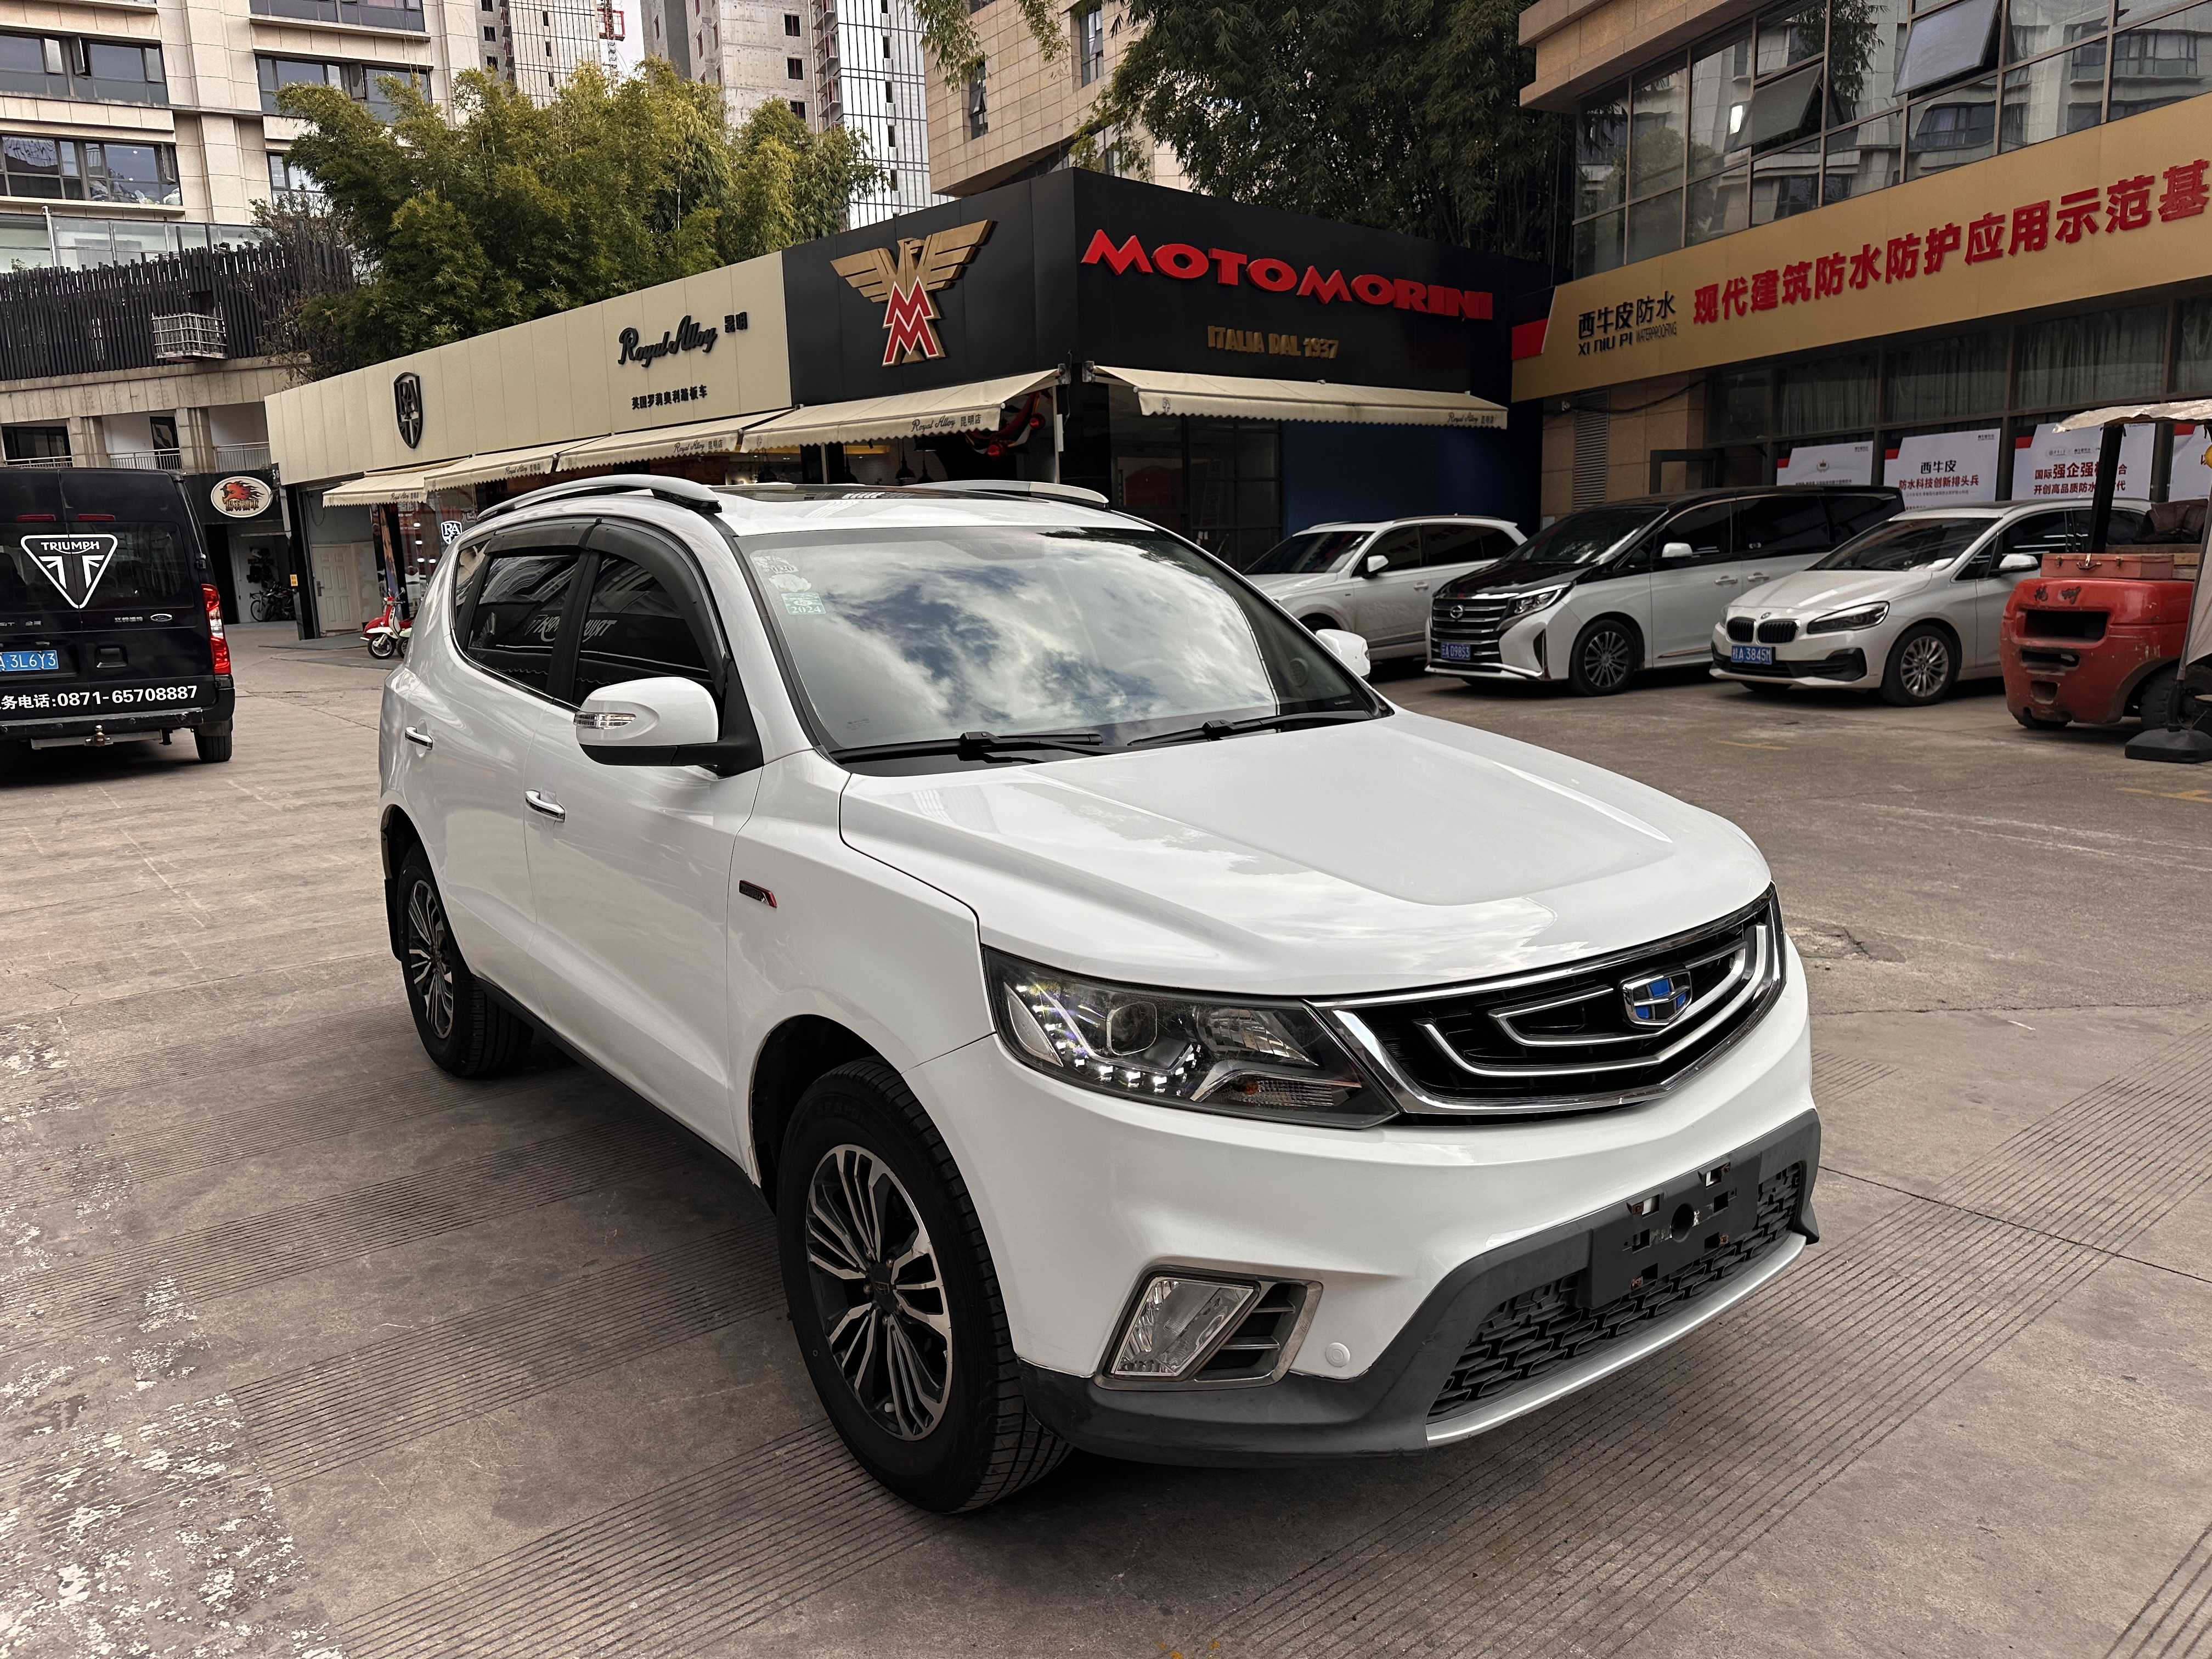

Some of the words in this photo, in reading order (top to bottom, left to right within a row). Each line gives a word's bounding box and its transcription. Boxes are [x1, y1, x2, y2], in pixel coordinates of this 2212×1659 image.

[1693, 158, 2210, 325] 现代建筑防水防护应用示范基
[1578, 290, 1677, 340] 西牛皮防水
[618, 327, 670, 368] Royal
[668, 315, 718, 353] Alloy
[724, 312, 747, 333] 昆明
[1207, 325, 1266, 353] ITALIA
[1268, 333, 1301, 356] DAL
[1304, 337, 1339, 359] 1937
[1578, 341, 1590, 356] XI
[1619, 331, 1633, 348] PI
[1636, 321, 1678, 348] WATERPROOFING
[911, 419, 934, 433] Royal
[935, 415, 955, 428] Alloy
[961, 414, 981, 427] 昆明店
[673, 442, 690, 454] Royal
[691, 439, 704, 451] Alloy
[1920, 459, 1957, 475] 西牛皮
[2034, 461, 2128, 480] 国际强企强合
[1898, 474, 1979, 490] 防水科技创新排头兵
[2033, 479, 2126, 495] 开创高品质防水代
[41, 541, 100, 554] TRIUMPH
[0, 685, 197, 710] 务电话:0871-65708887
